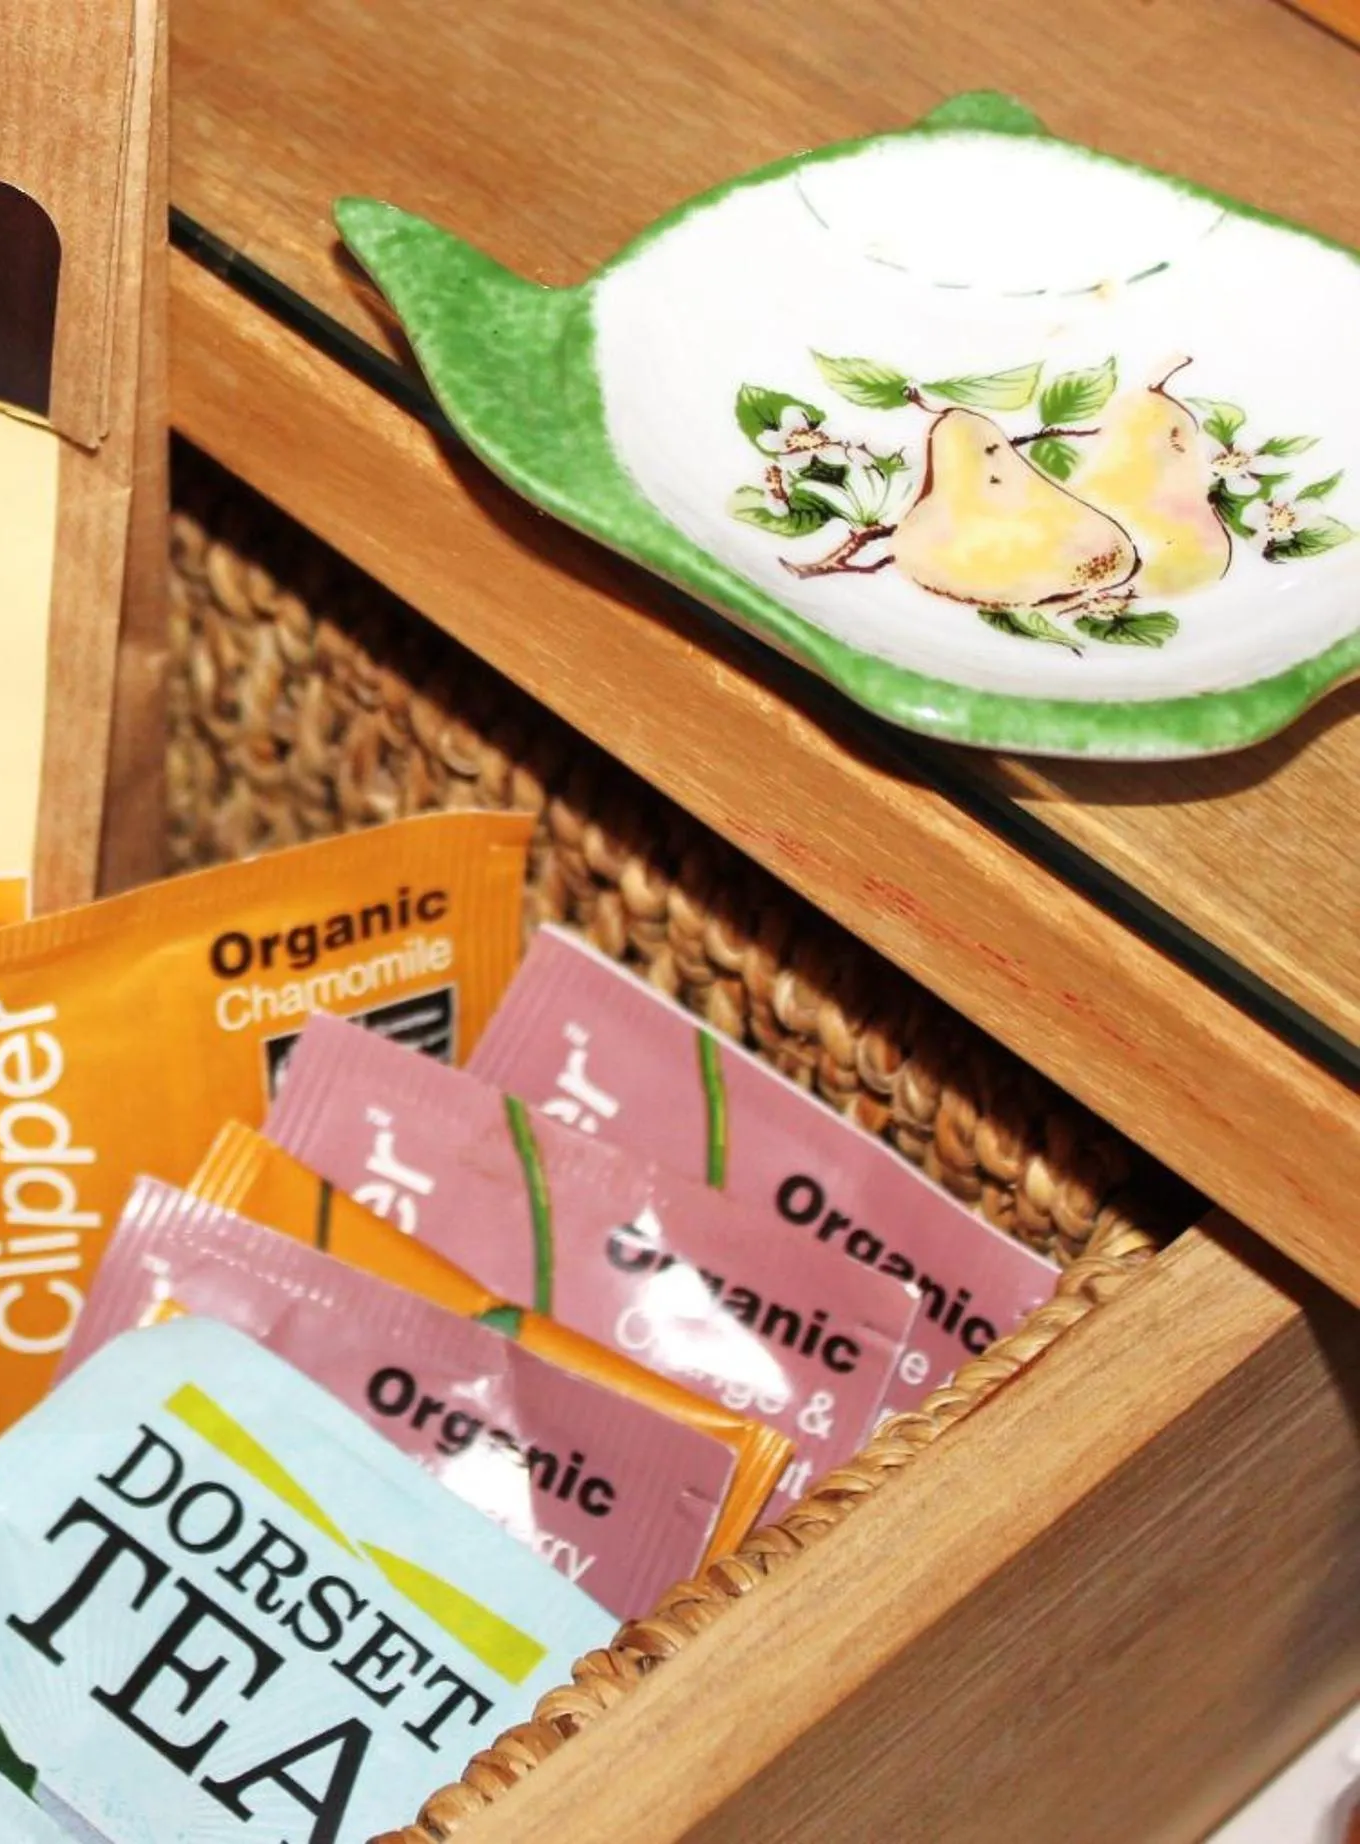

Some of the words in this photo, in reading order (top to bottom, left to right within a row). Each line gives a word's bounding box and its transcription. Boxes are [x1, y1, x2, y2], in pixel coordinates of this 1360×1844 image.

[210, 886, 449, 981] Organic
[214, 936, 454, 1033] Chamomile
[606, 1223, 862, 1374] Oanic
[798, 1390, 835, 1439] &
[97, 1424, 495, 1754] DORSET
[6, 1496, 376, 1844] TEA
